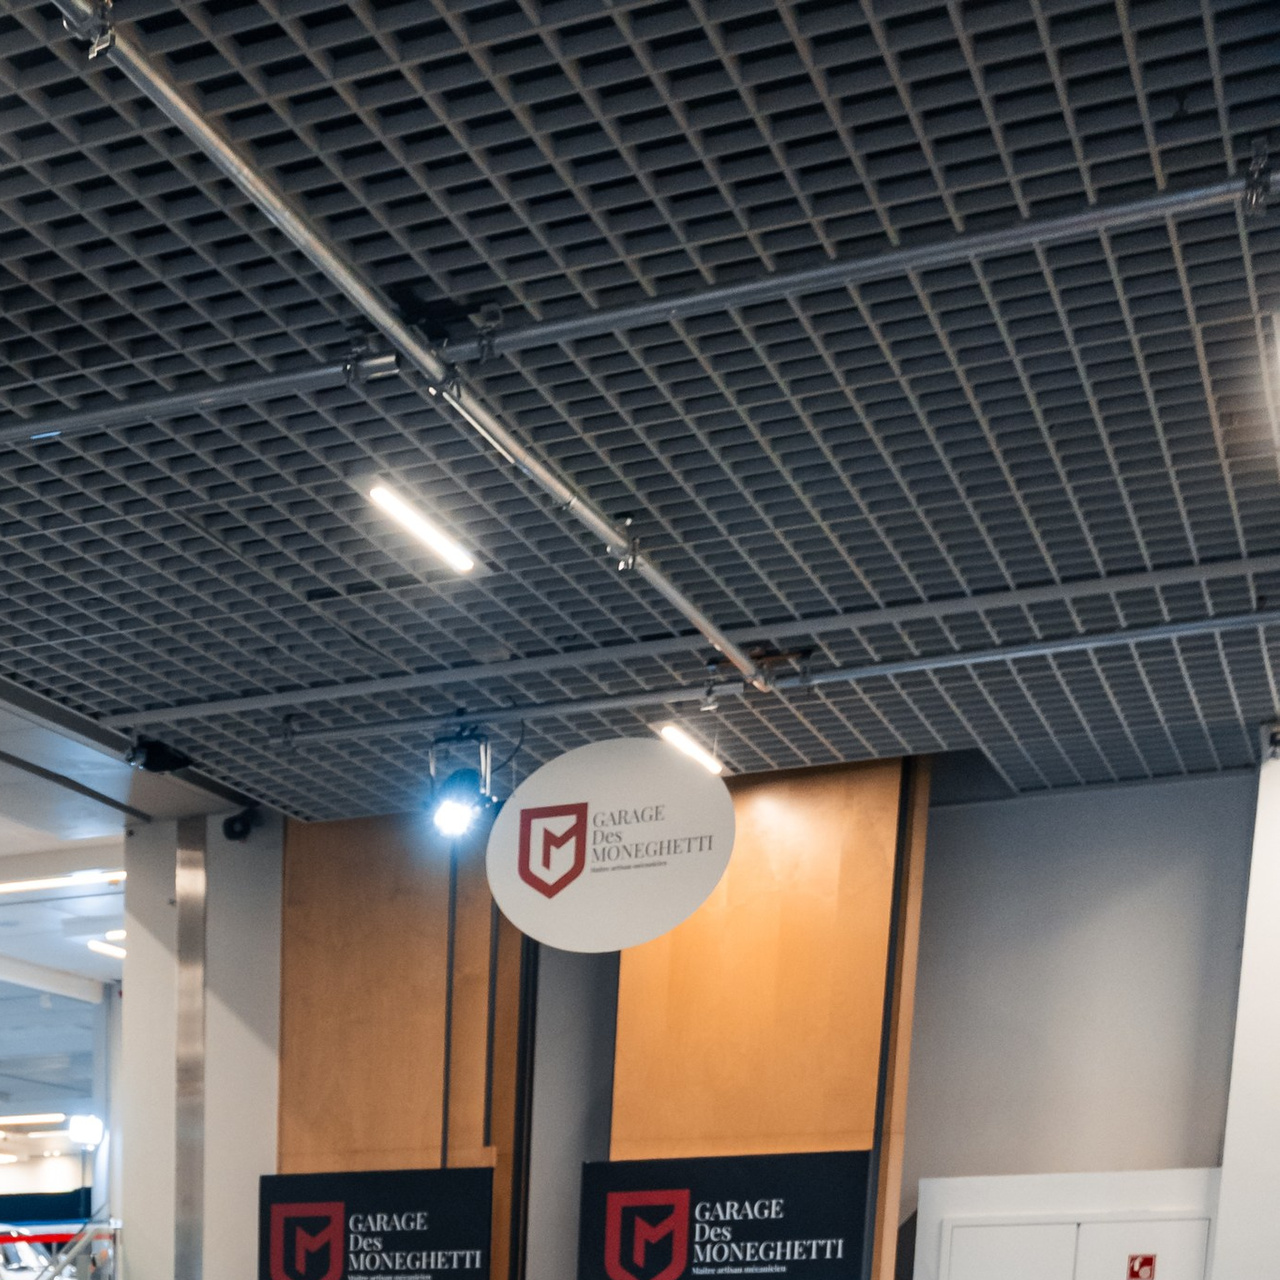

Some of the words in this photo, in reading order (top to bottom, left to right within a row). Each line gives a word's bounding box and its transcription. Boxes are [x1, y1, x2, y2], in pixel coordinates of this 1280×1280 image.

[592, 804, 666, 829] GARAGE
[591, 829, 623, 846] Des
[590, 835, 714, 864] MONEGHETTI
[694, 1199, 785, 1222] GARAGE
[348, 1212, 429, 1233] GARAGE
[693, 1222, 732, 1243] Des
[348, 1233, 383, 1251] Des
[692, 1238, 844, 1264] MONEGHETTI
[347, 1250, 482, 1271] MONEGHETTI
